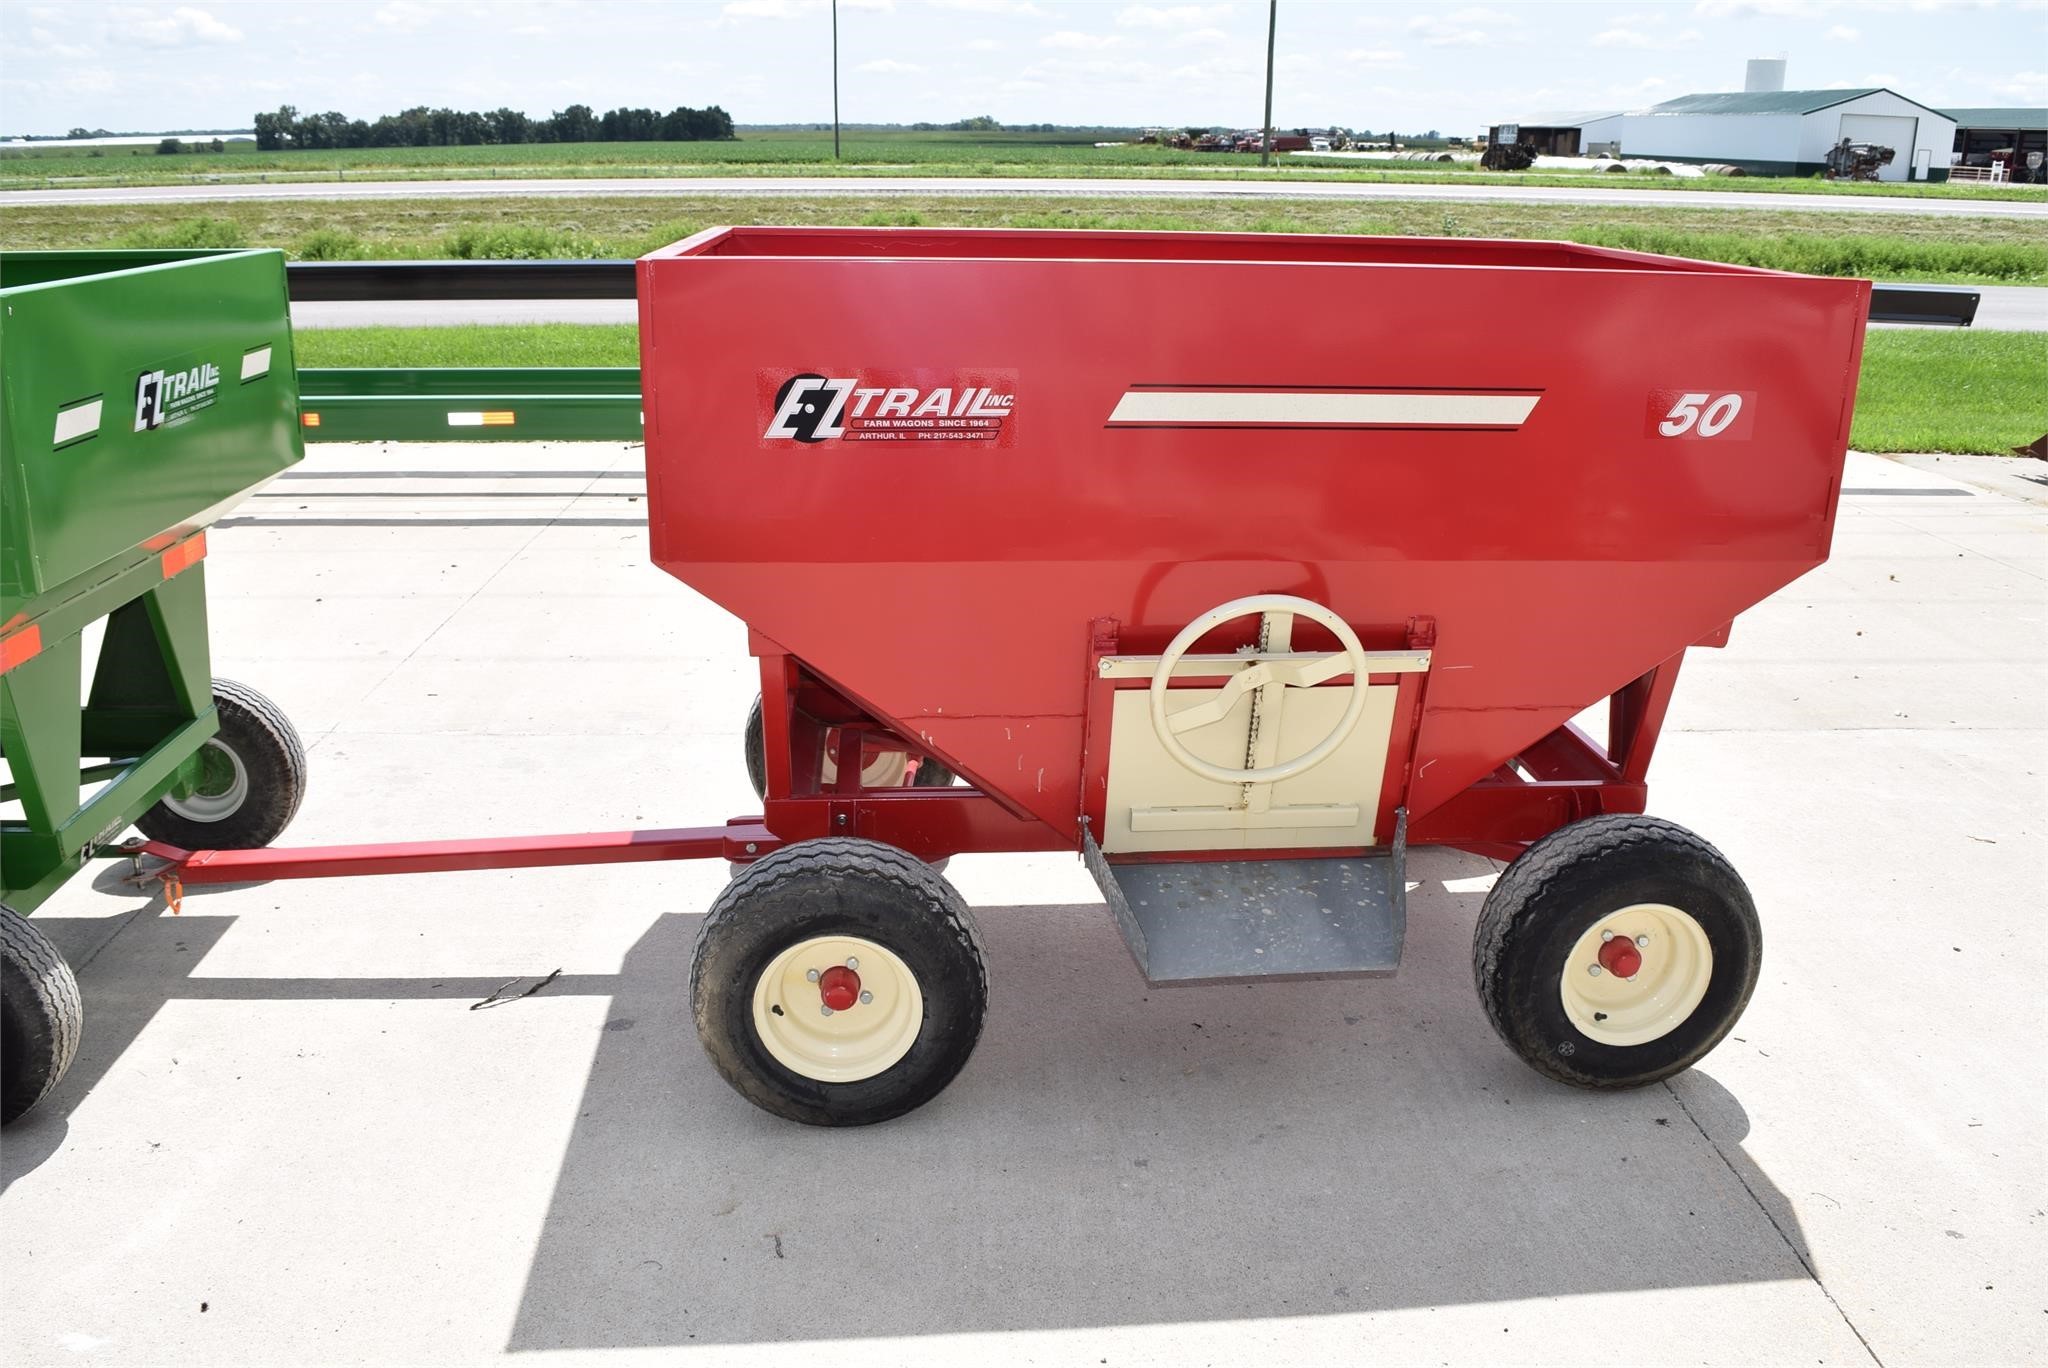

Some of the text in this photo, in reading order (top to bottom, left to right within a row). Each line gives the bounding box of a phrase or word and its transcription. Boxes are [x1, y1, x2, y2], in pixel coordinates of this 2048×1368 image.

[164, 363, 220, 402] TRAIL
[851, 388, 1013, 417] TRAIL
[1658, 393, 1743, 437] 50
[864, 420, 891, 428] FARM
[899, 432, 906, 440] IL
